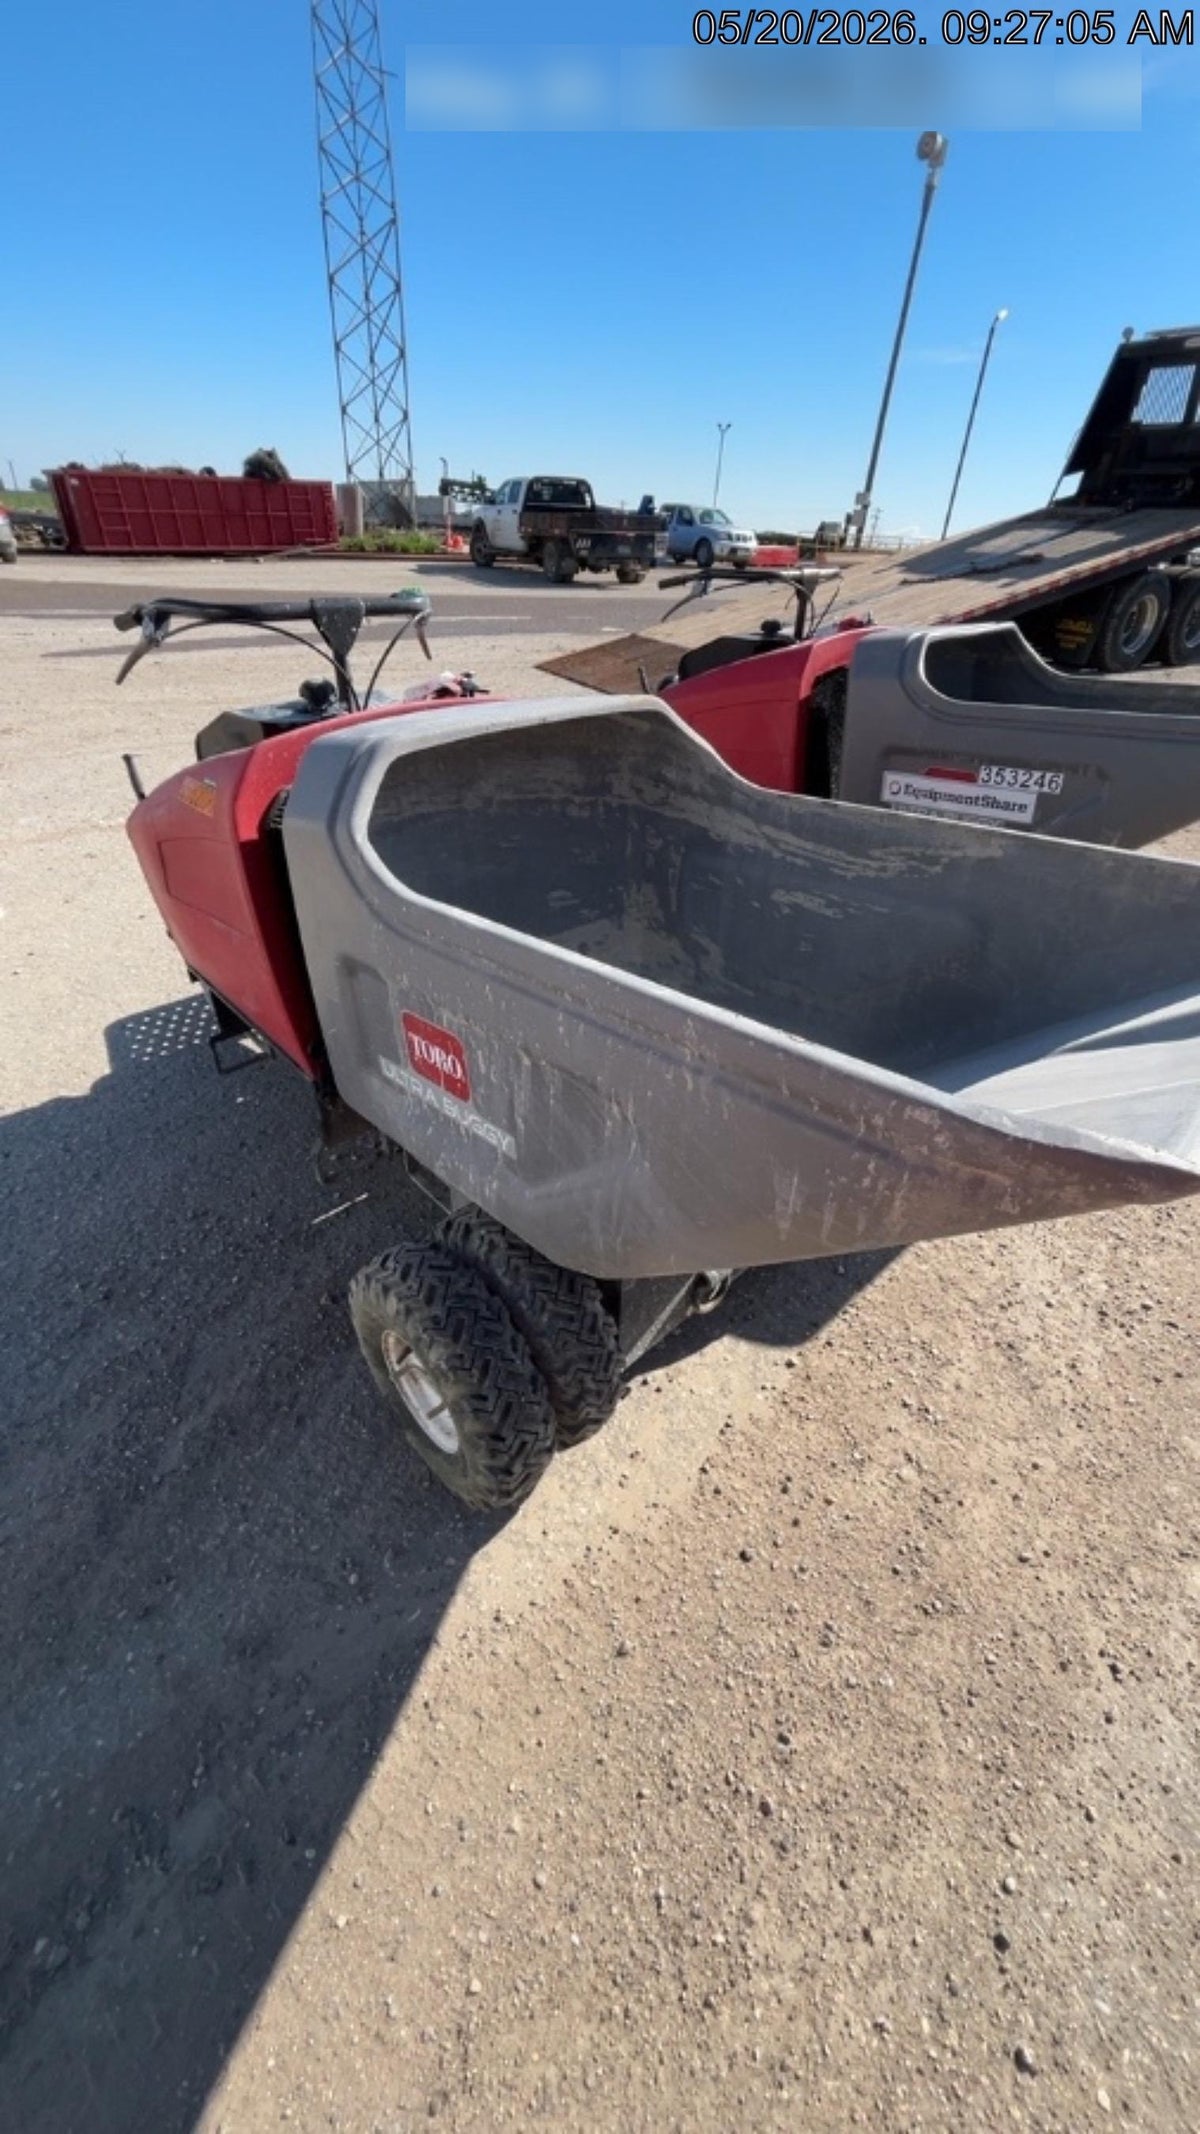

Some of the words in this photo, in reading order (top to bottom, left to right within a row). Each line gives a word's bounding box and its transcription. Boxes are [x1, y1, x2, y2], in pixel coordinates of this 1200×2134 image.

[980, 767, 1062, 793] 353246
[903, 783, 1028, 814] EquipmentShare
[408, 1031, 463, 1080] TORO
